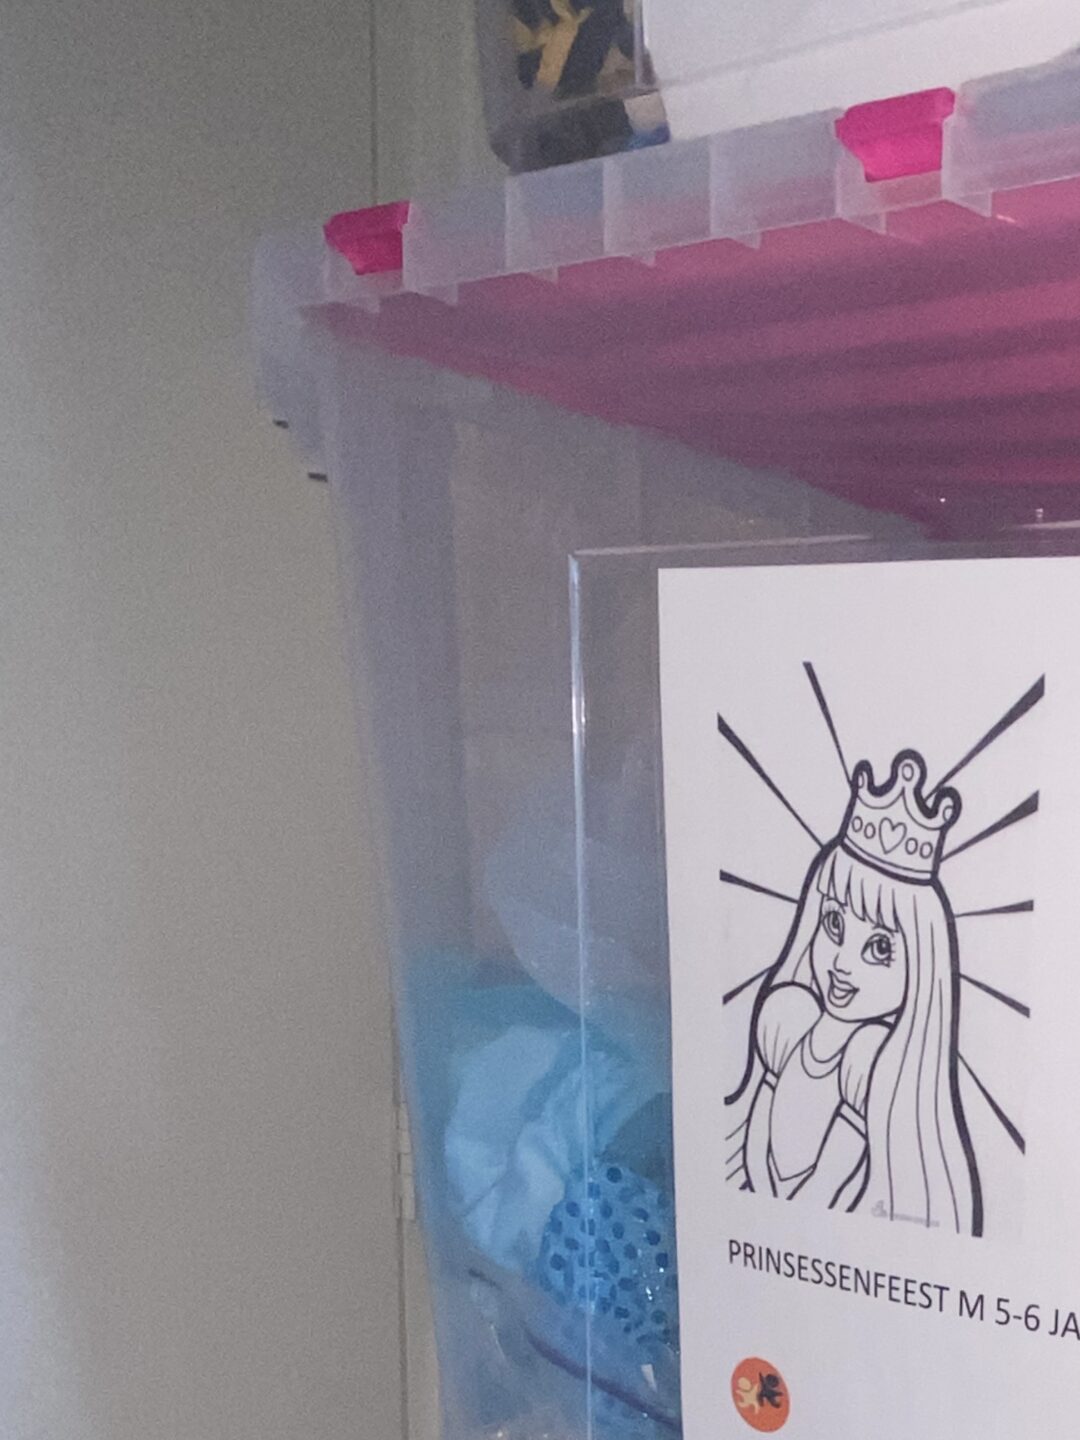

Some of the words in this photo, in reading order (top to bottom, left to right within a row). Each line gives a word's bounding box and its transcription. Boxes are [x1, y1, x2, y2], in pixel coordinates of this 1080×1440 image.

[728, 1239, 950, 1313] PRINSESSENFEEST
[958, 1290, 985, 1321] M
[995, 1298, 1041, 1332] 5-6
